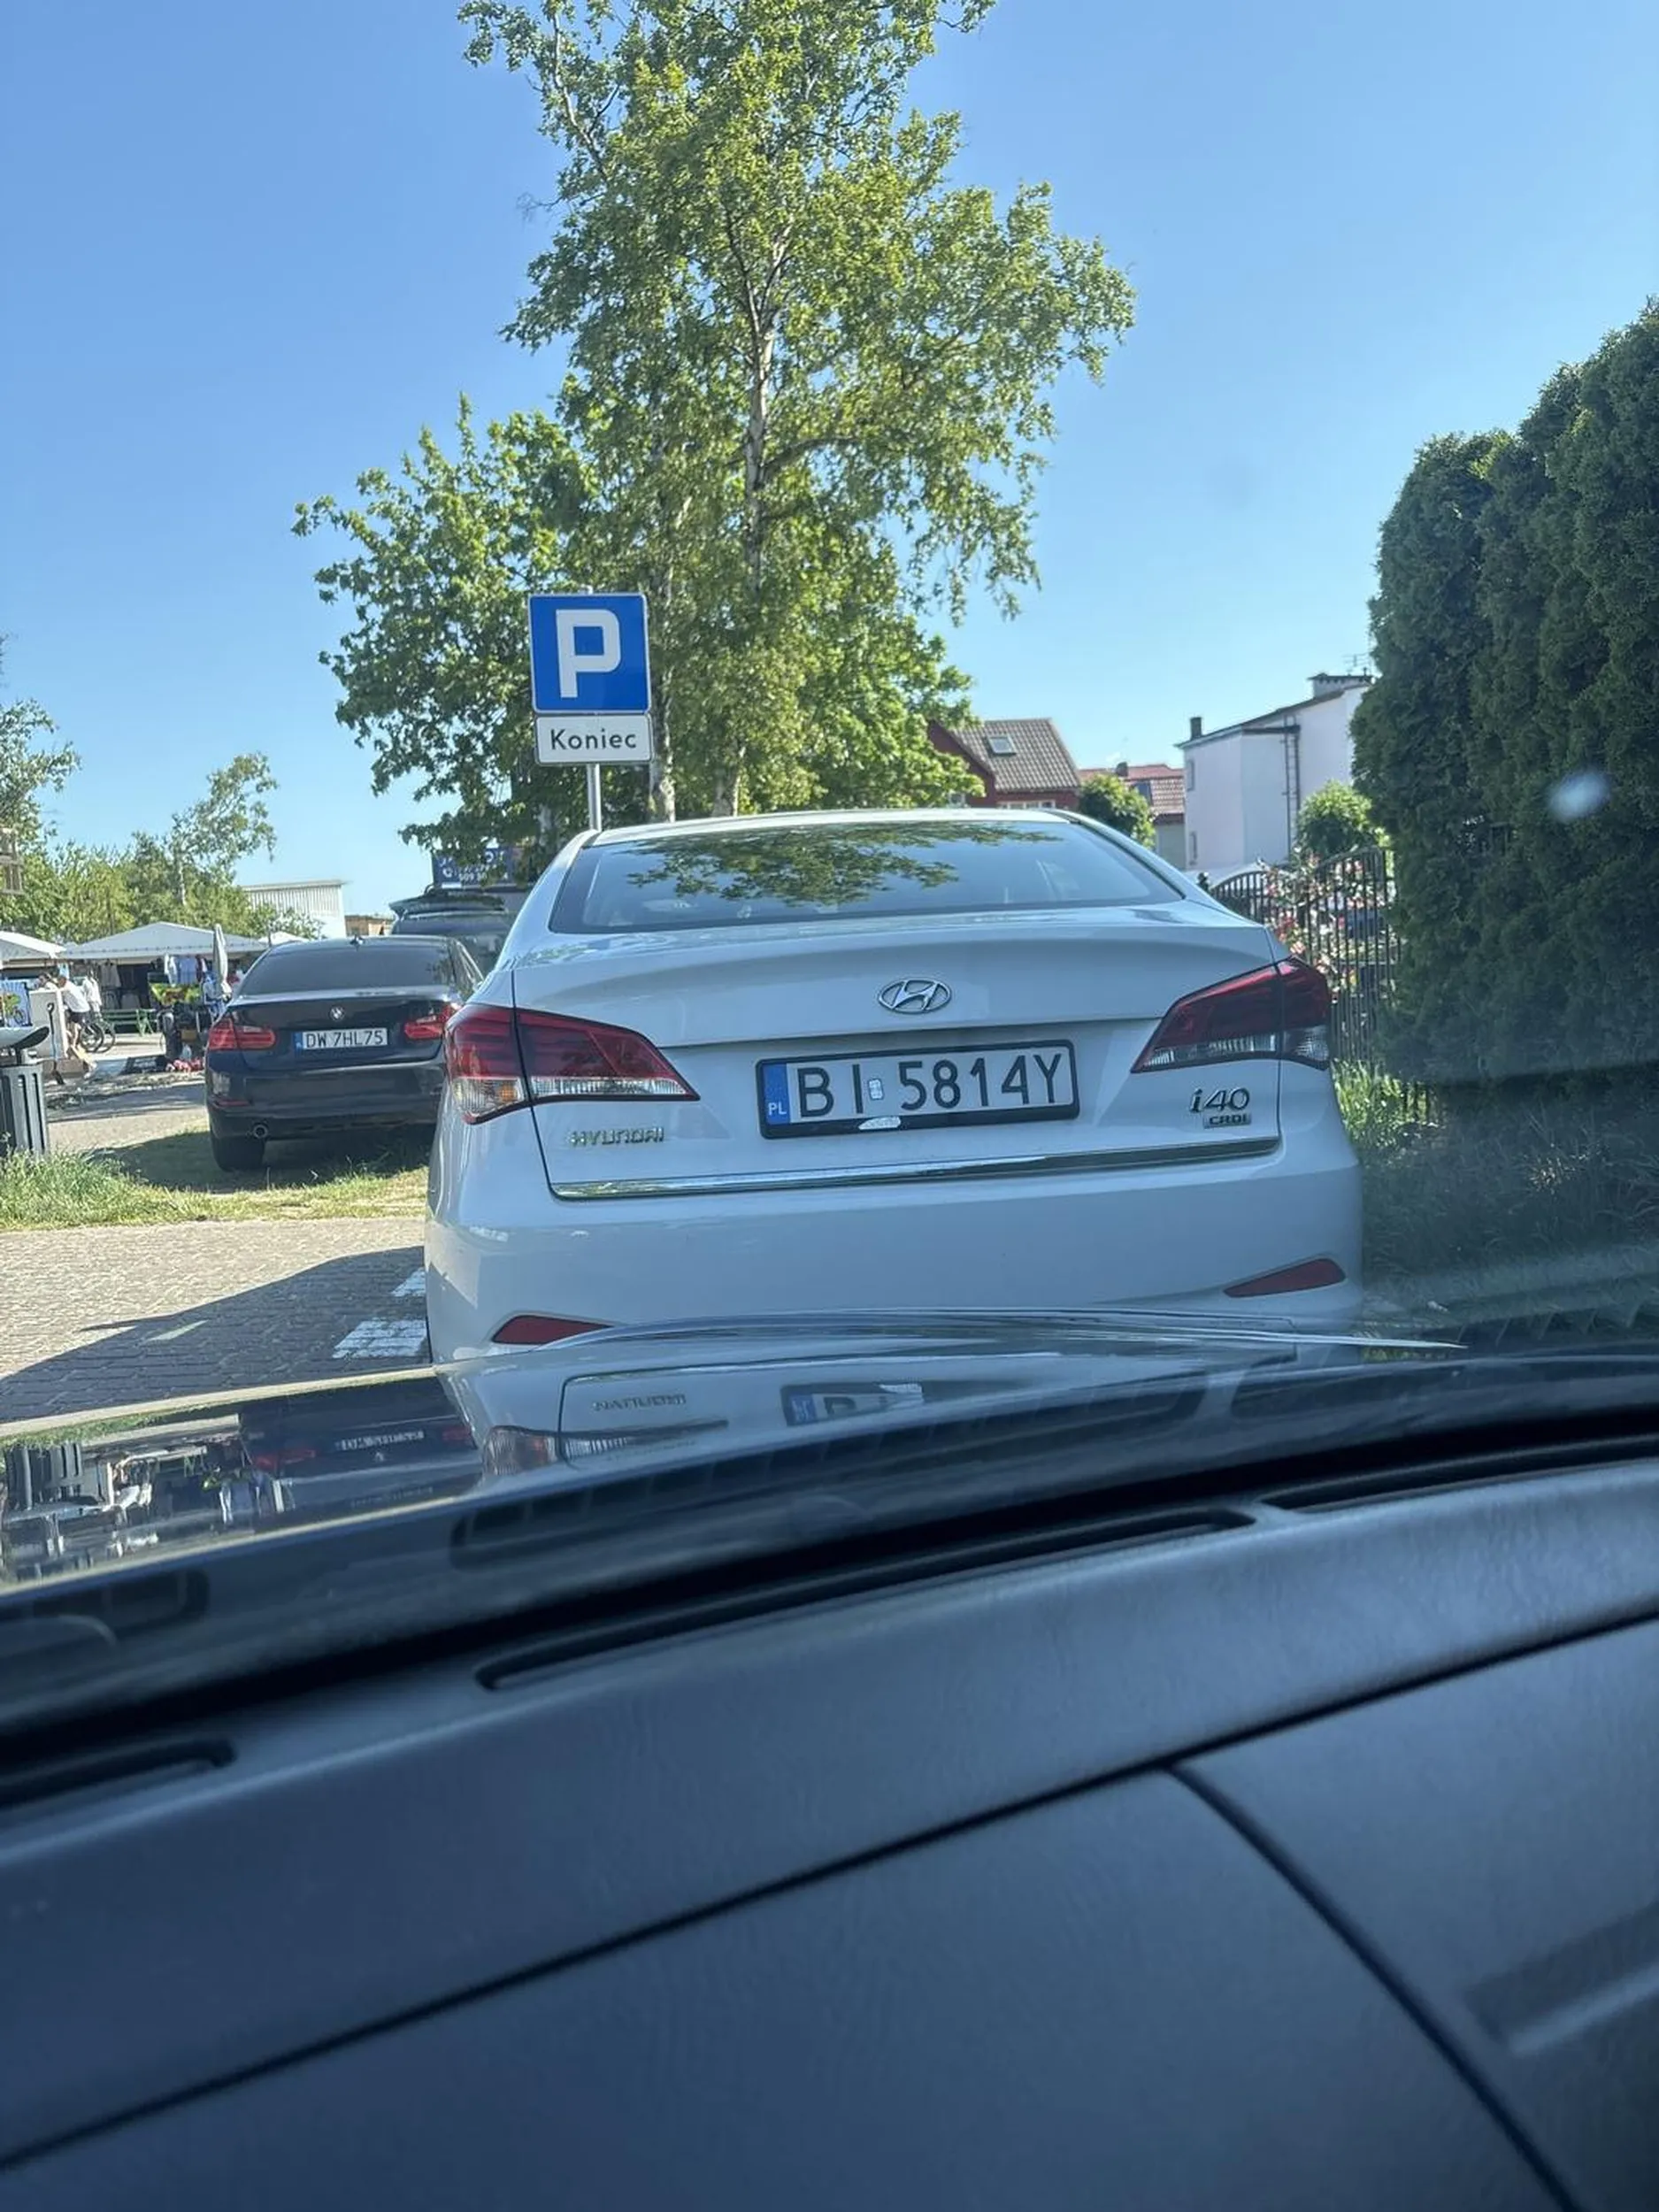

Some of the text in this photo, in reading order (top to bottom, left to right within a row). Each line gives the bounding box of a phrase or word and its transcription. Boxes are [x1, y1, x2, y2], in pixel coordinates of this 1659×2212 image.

[556, 609, 621, 698] P
[550, 728, 637, 750] Koniec
[306, 1033, 326, 1048] DW
[334, 1030, 383, 1046] 7HL75
[797, 1053, 1061, 1118] BI 5814Y
[768, 1102, 787, 1115] PL
[1190, 1087, 1249, 1112] i40
[569, 1127, 664, 1146] HYUNDAI
